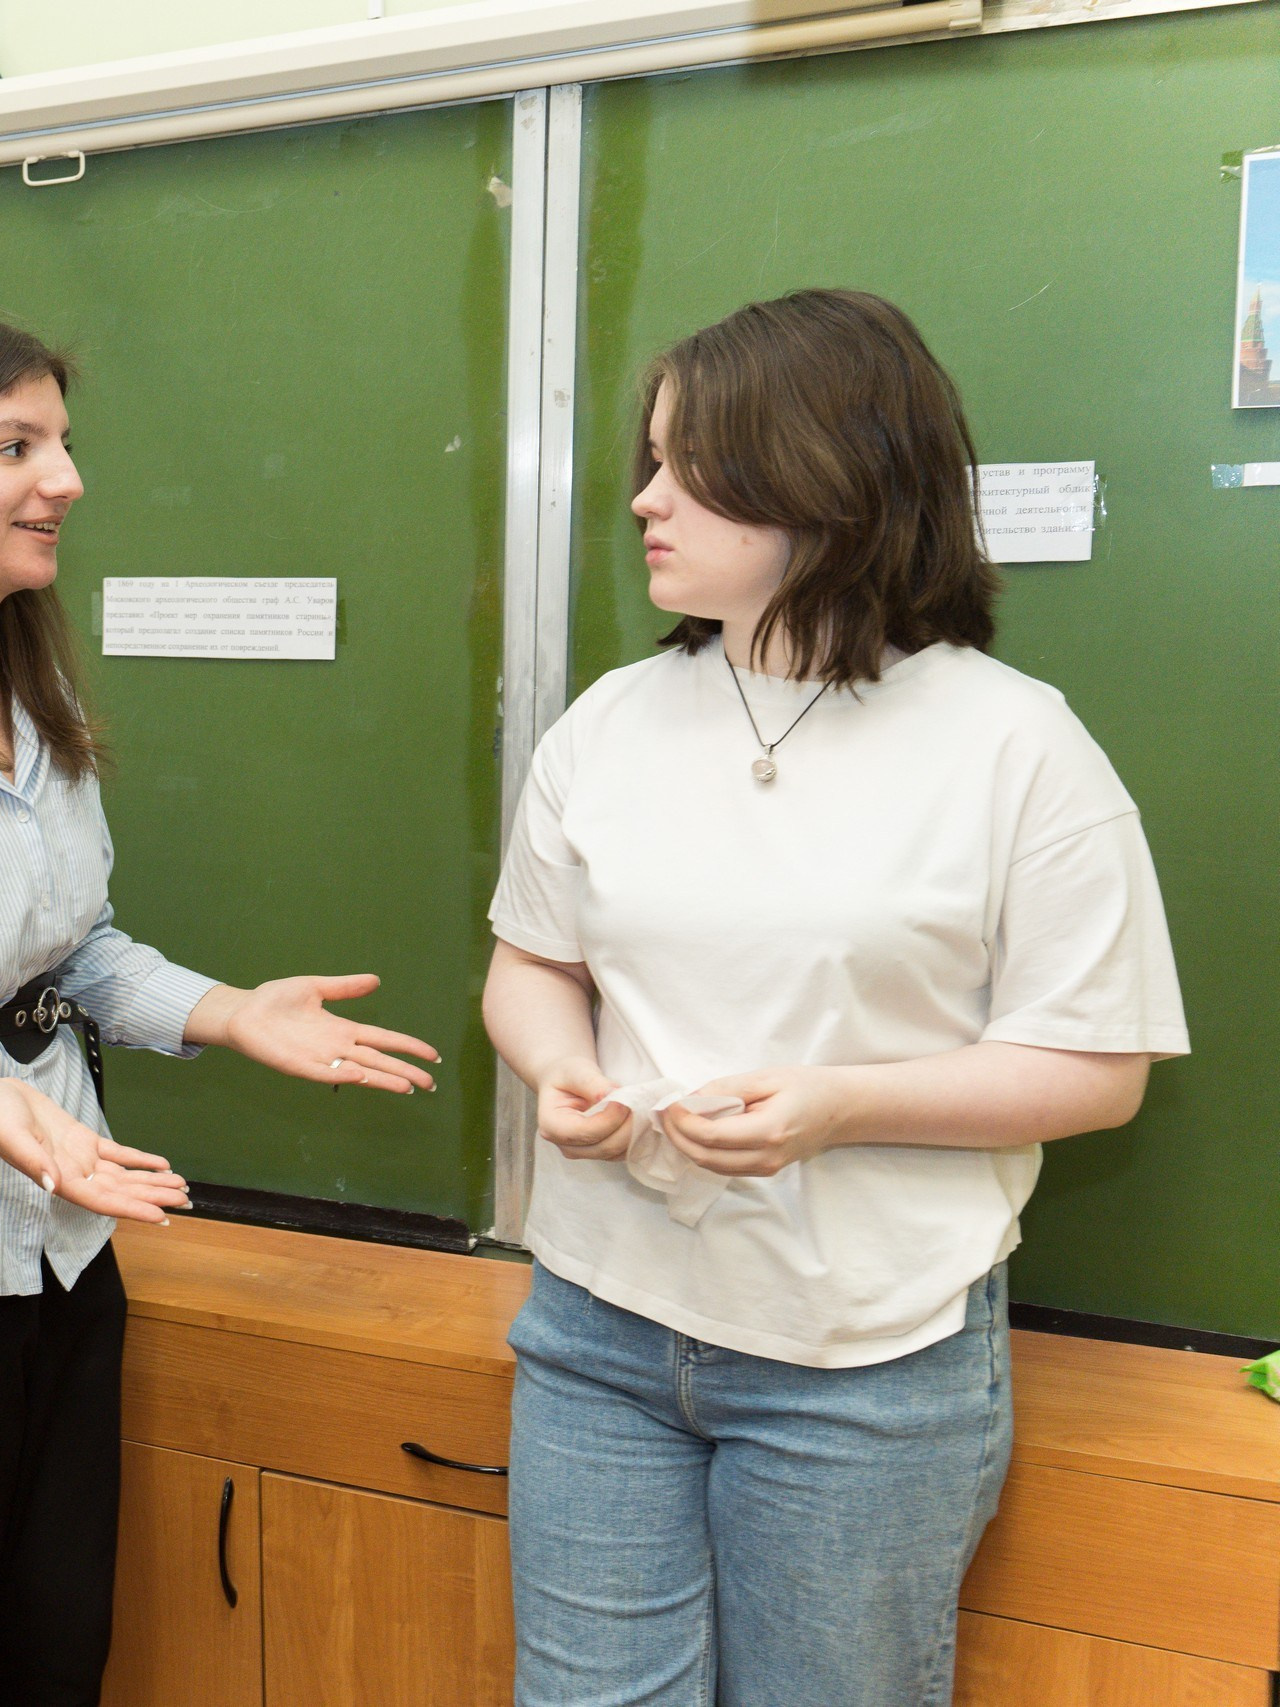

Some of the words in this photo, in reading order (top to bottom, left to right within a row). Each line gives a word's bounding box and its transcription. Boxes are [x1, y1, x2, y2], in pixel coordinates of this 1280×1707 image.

[982, 468, 1011, 480] устав
[1018, 468, 1025, 476] и
[1033, 466, 1092, 477] программу
[971, 484, 1050, 497] хитектурный
[1059, 484, 1091, 494] облик
[262, 596, 280, 606] граф
[297, 628, 324, 636] России
